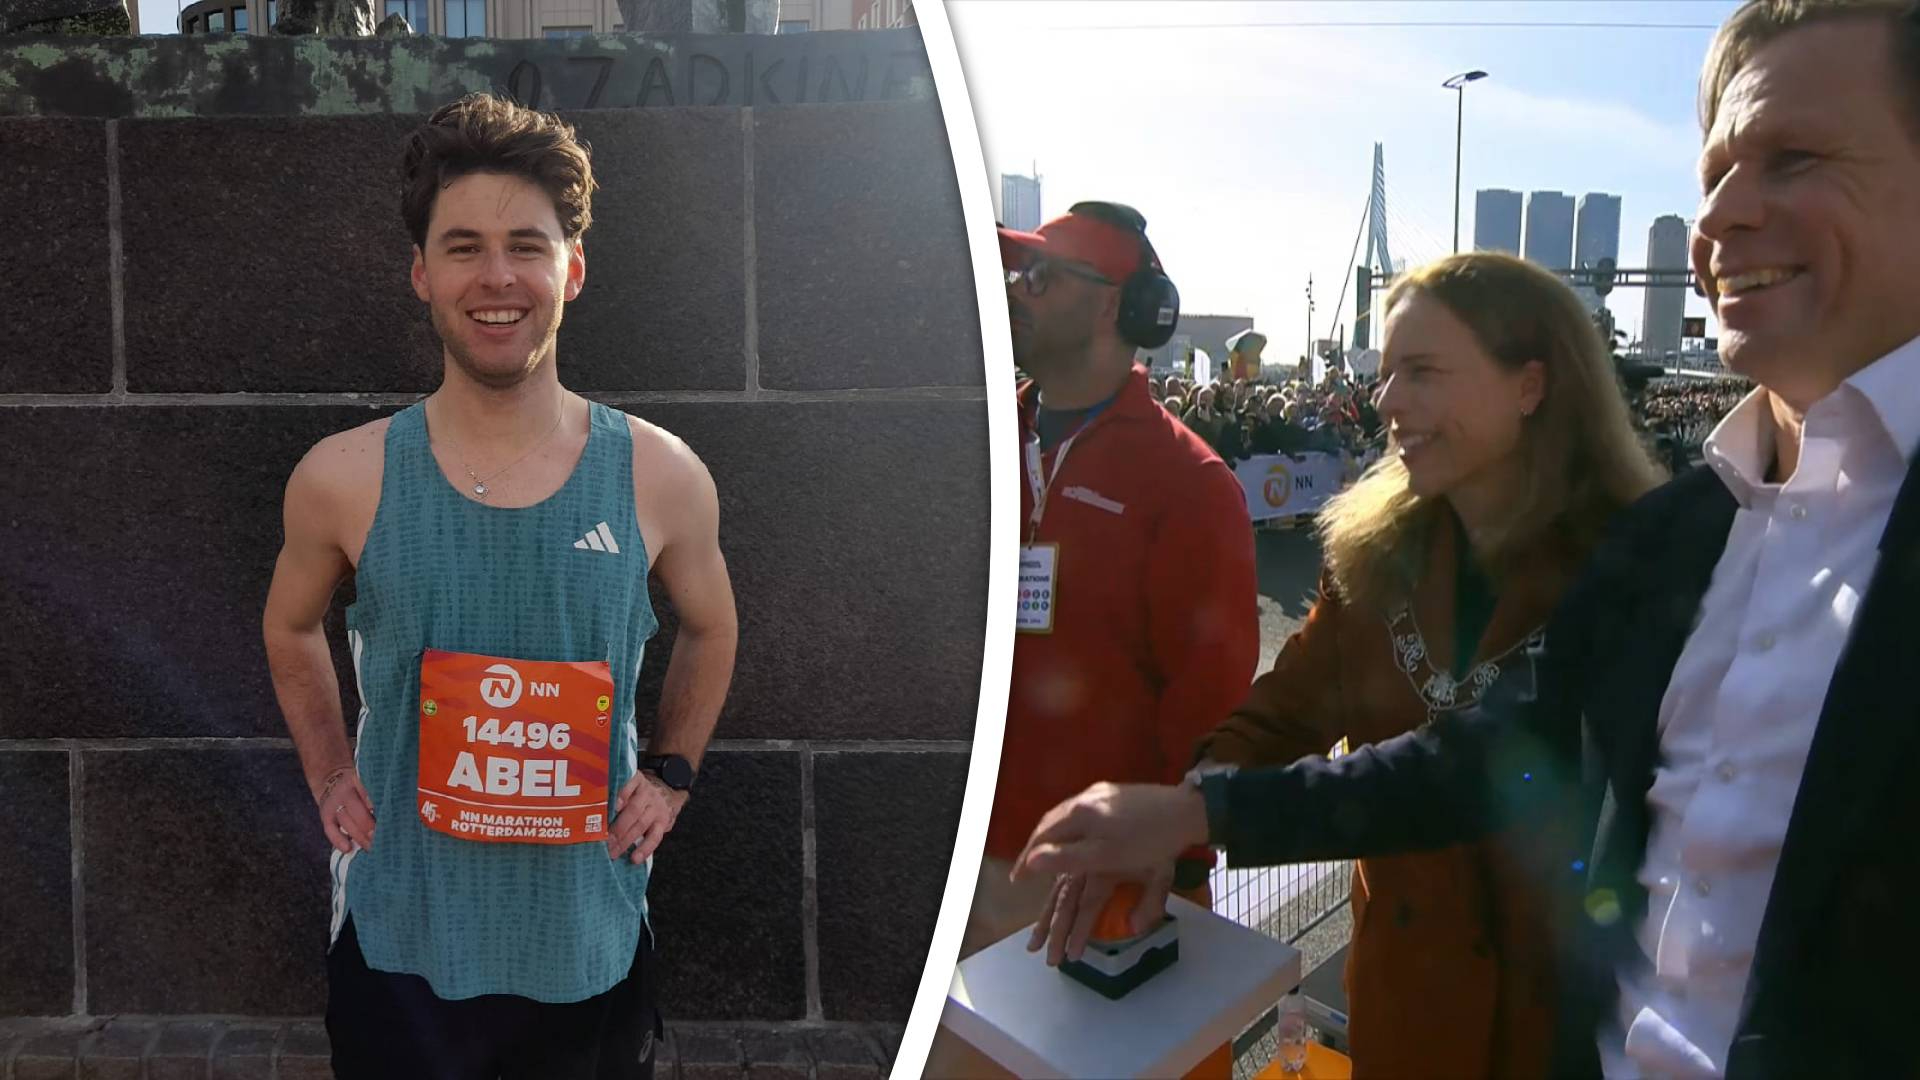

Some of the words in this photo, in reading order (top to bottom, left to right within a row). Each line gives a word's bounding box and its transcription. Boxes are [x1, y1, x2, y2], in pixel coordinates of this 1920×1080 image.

[1295, 476, 1313, 489] NN
[530, 682, 560, 697] NN
[463, 716, 570, 750] 14496
[447, 751, 581, 796] ABEL
[460, 810, 481, 822] NN
[482, 812, 563, 827] MARATHON
[451, 820, 536, 838] ROTTERDAM
[537, 828, 571, 839] 2026
